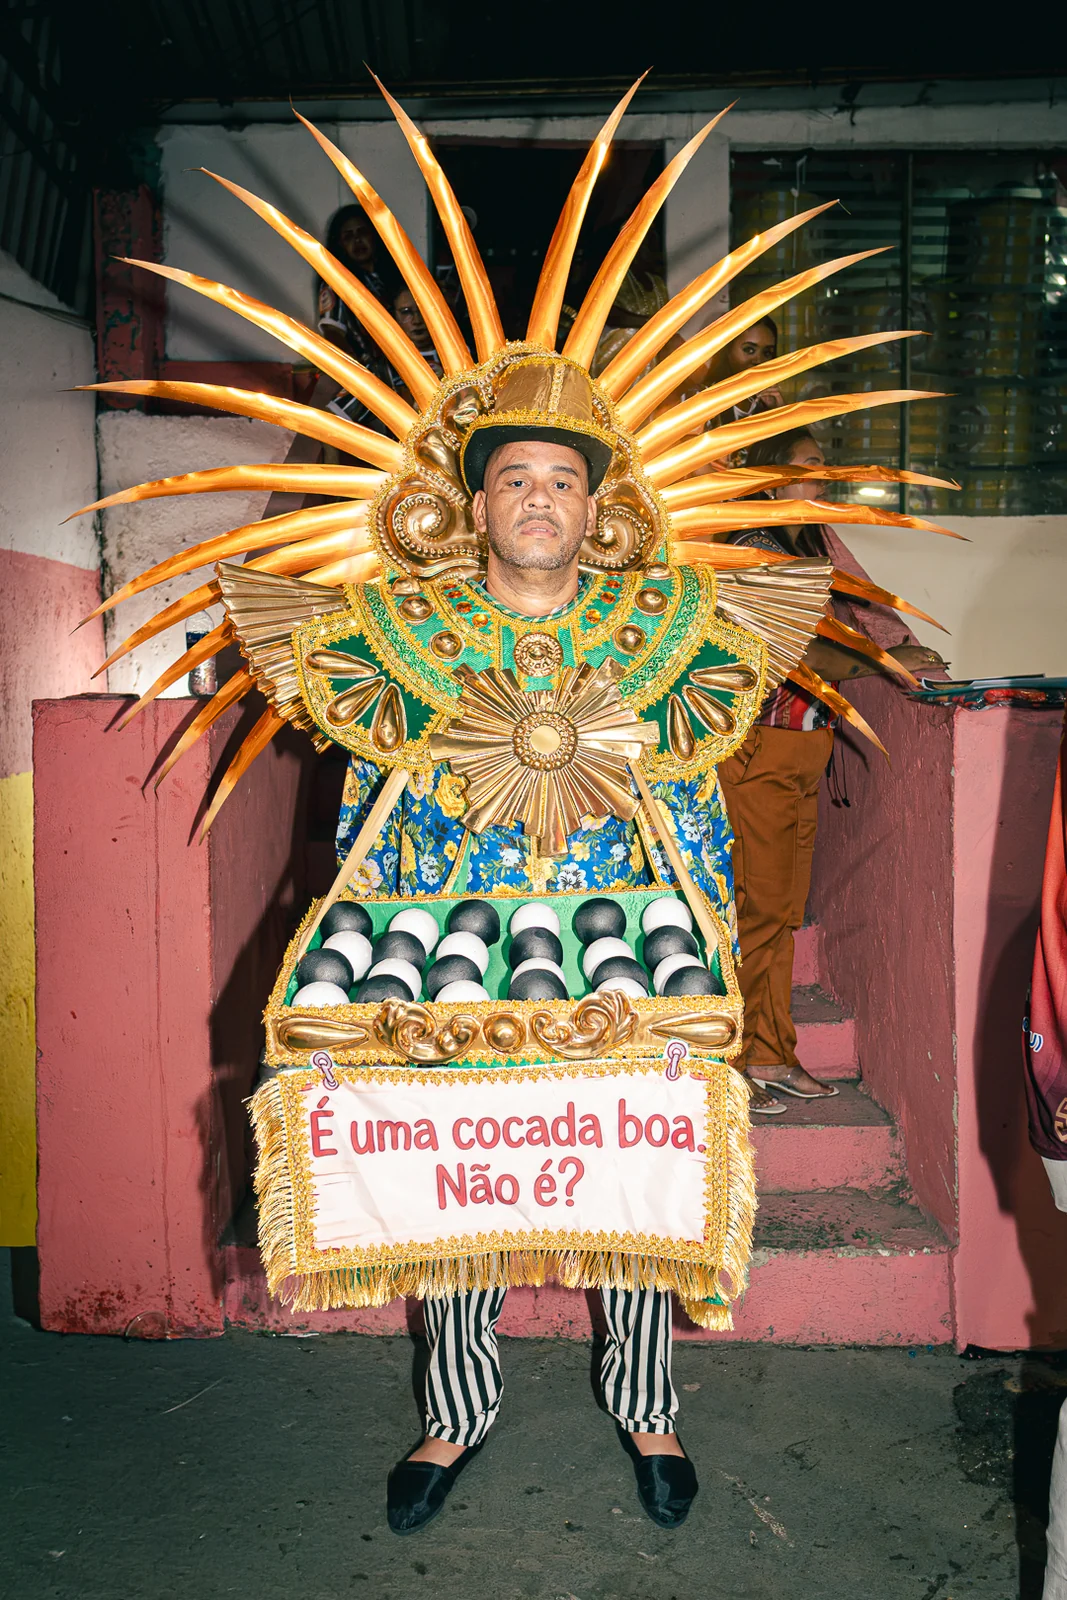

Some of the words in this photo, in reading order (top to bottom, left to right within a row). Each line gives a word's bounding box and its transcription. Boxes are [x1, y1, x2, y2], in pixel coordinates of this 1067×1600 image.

[310, 1096, 338, 1158] É
[350, 1117, 439, 1155] uma
[452, 1101, 603, 1151] cocada
[618, 1098, 707, 1154] boa.
[436, 1163, 520, 1210] Não
[533, 1156, 585, 1207] é?
